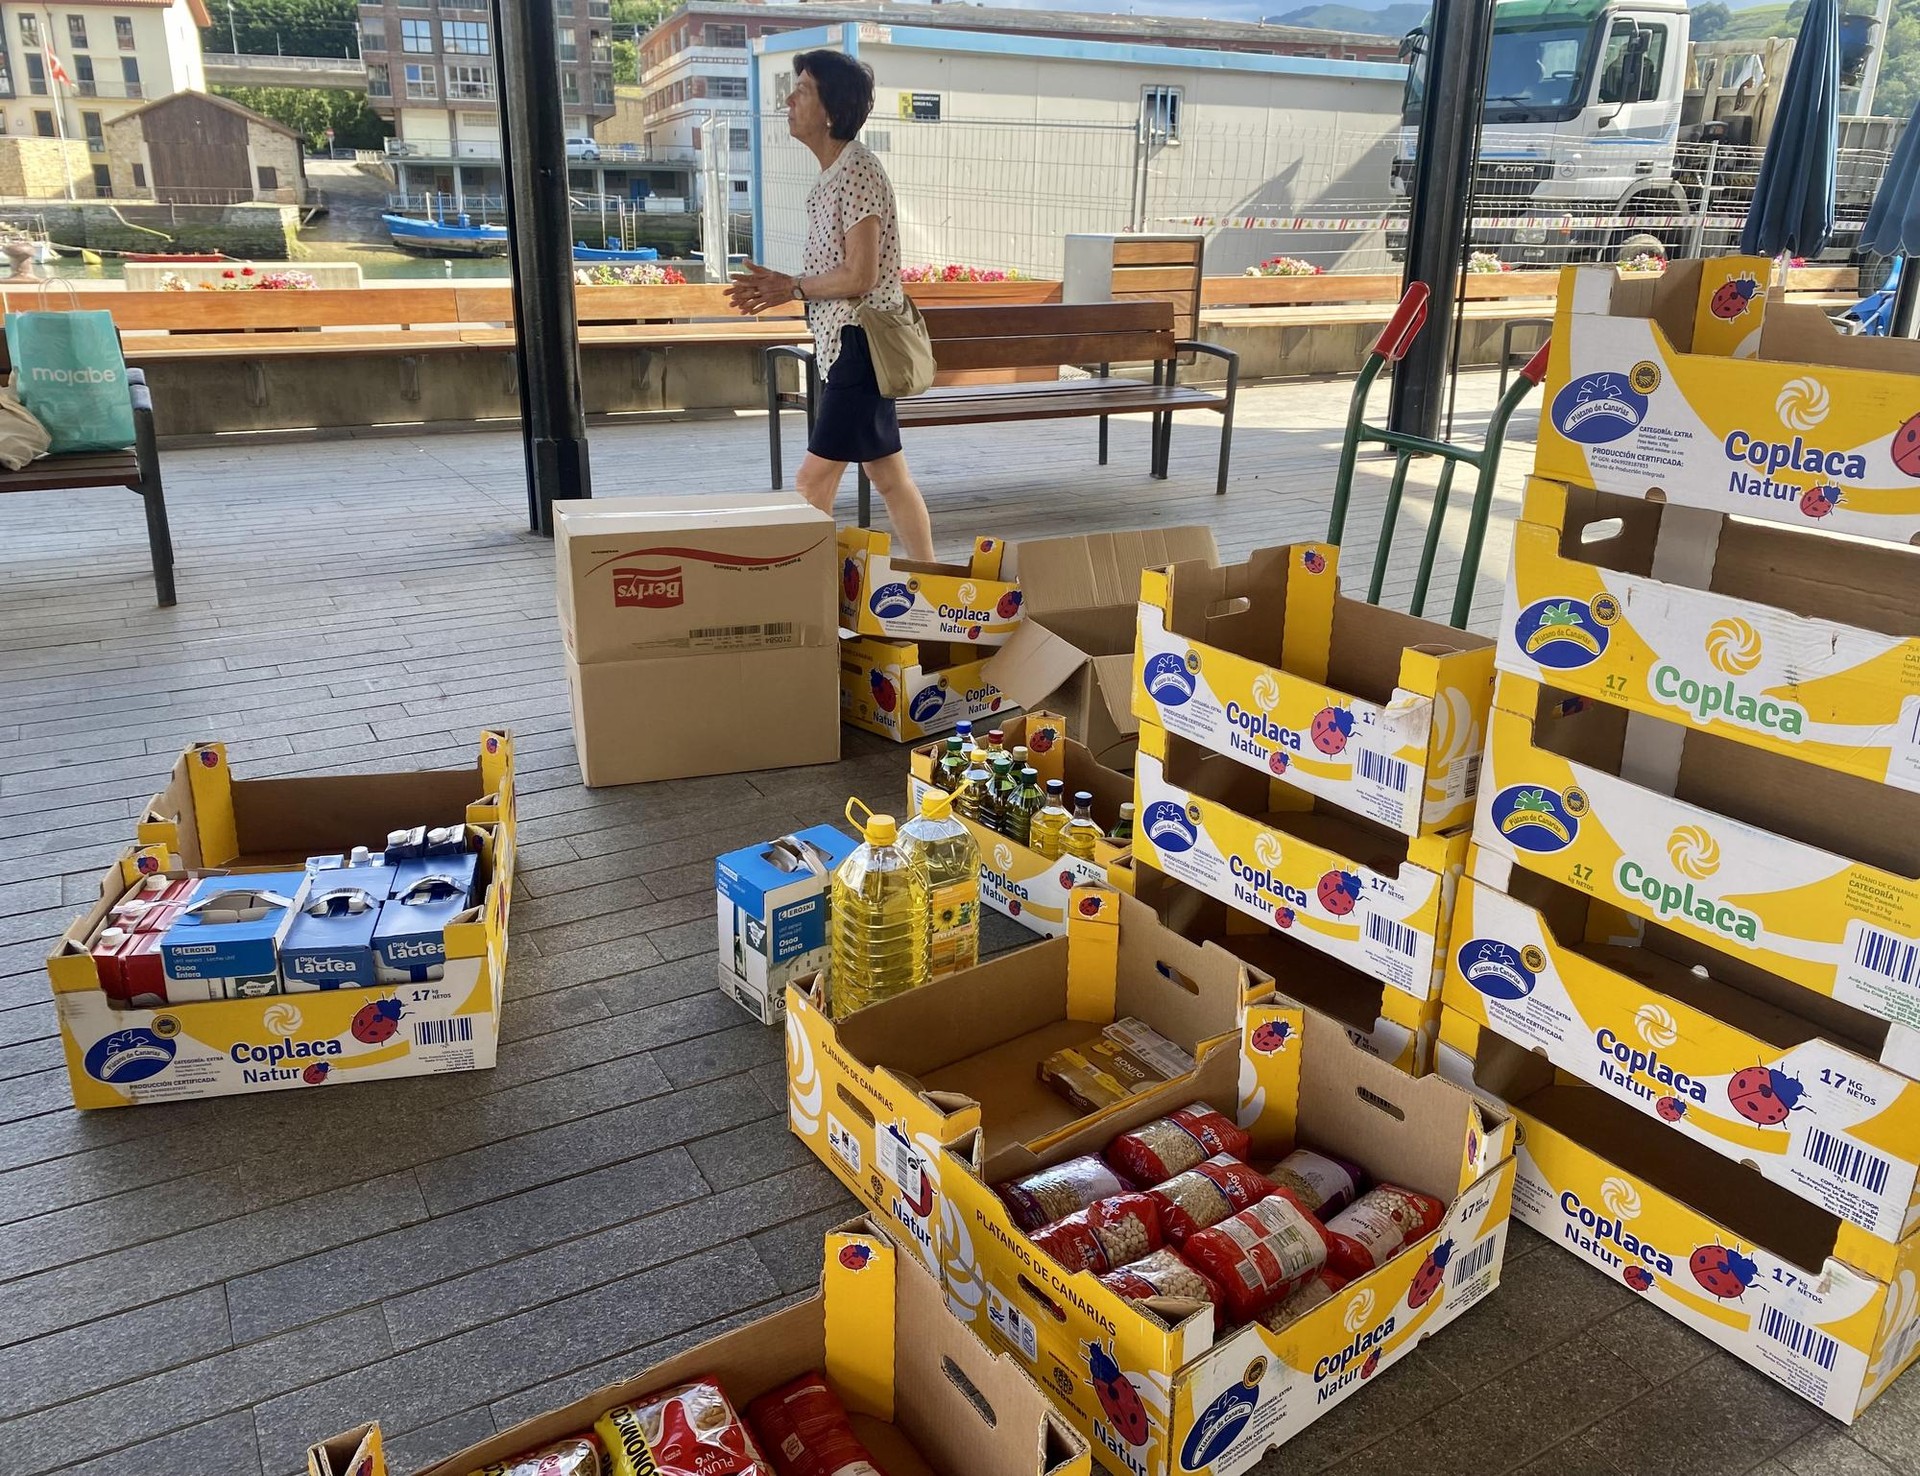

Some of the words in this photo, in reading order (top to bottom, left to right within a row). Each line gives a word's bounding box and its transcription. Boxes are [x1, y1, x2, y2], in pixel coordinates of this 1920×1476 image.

[31, 366, 117, 387] mojabe
[1571, 407, 1594, 423] Plátano
[1594, 403, 1602, 412] de
[1602, 402, 1630, 417] Canarias
[1674, 431, 1693, 439] EXTRA
[1592, 446, 1636, 460] PRODUCCIÓN
[1636, 453, 1684, 467] CERTIFICADA:
[1725, 430, 1867, 480] Coplaca
[1728, 471, 1801, 502] Natur
[617, 578, 681, 600] Berlys
[938, 604, 990, 622] Coplaca
[940, 622, 967, 634] Natur
[1556, 626, 1565, 636] de
[765, 635, 792, 644] 210584
[1605, 674, 1628, 692] 17
[968, 701, 990, 715] Natur
[1654, 665, 1803, 735] Coplaca
[873, 711, 896, 727] Natur
[1226, 701, 1301, 751] Coplaca
[1230, 731, 1269, 761] Natur
[1508, 814, 1530, 827] Plátano
[1529, 814, 1537, 823] de
[1076, 863, 1088, 876] 17
[1573, 863, 1594, 882] 17
[980, 863, 1029, 901] Coplaca
[1229, 855, 1308, 909] Coplaca
[1371, 877, 1387, 892] 17
[1576, 878, 1594, 892] NETOS
[1849, 880, 1894, 900] CATEGORÍA
[982, 882, 1008, 905] Natur
[1234, 882, 1274, 914] Natur
[1619, 861, 1758, 942] Coplaca
[789, 903, 814, 916] EROSKI
[184, 946, 215, 954] EROSKI
[779, 936, 798, 947] Osoa
[780, 942, 803, 956] Entera
[174, 964, 197, 972] Osoa
[412, 989, 430, 1002] 17
[1490, 999, 1526, 1022] PRODUCCIÓN
[1526, 1018, 1564, 1042] CERTIFICADA:
[230, 1037, 343, 1066] Coplaca
[243, 1067, 300, 1084] Natur
[1114, 1056, 1146, 1079] BONITO
[1596, 1028, 1708, 1104] Coplaca
[129, 1080, 173, 1090] PRODUCCIÓN
[174, 1077, 218, 1087] CERTIFICADA:
[1599, 1060, 1656, 1101] Natur
[1819, 1067, 1847, 1089] 17
[1848, 1078, 1863, 1091] KG
[850, 1069, 859, 1083] DE
[860, 1078, 894, 1112] CANARIAS
[1846, 1086, 1877, 1106] NETOS
[1226, 1172, 1249, 1204] luengo
[1820, 1178, 1846, 1194] COPLACA
[892, 1198, 932, 1248] Natur
[1460, 1202, 1476, 1223] 17
[1560, 1190, 1674, 1278] Coplaca
[1072, 1236, 1090, 1268] lueng
[1565, 1223, 1623, 1268] Natur
[976, 1209, 1031, 1266] PLATANOS
[1033, 1260, 1050, 1283] DE
[1051, 1276, 1117, 1337] CANARIAS
[1772, 1268, 1798, 1287] 17
[1798, 1278, 1808, 1290] kg
[1798, 1286, 1823, 1304] NETOS
[1313, 1316, 1396, 1384] Coplaca
[1317, 1364, 1361, 1405] Natur
[1198, 1428, 1217, 1452] Plátano
[1216, 1420, 1224, 1430] de
[1093, 1418, 1148, 1476] Natur
[1218, 1434, 1253, 1463] PRODUCCIÓN
